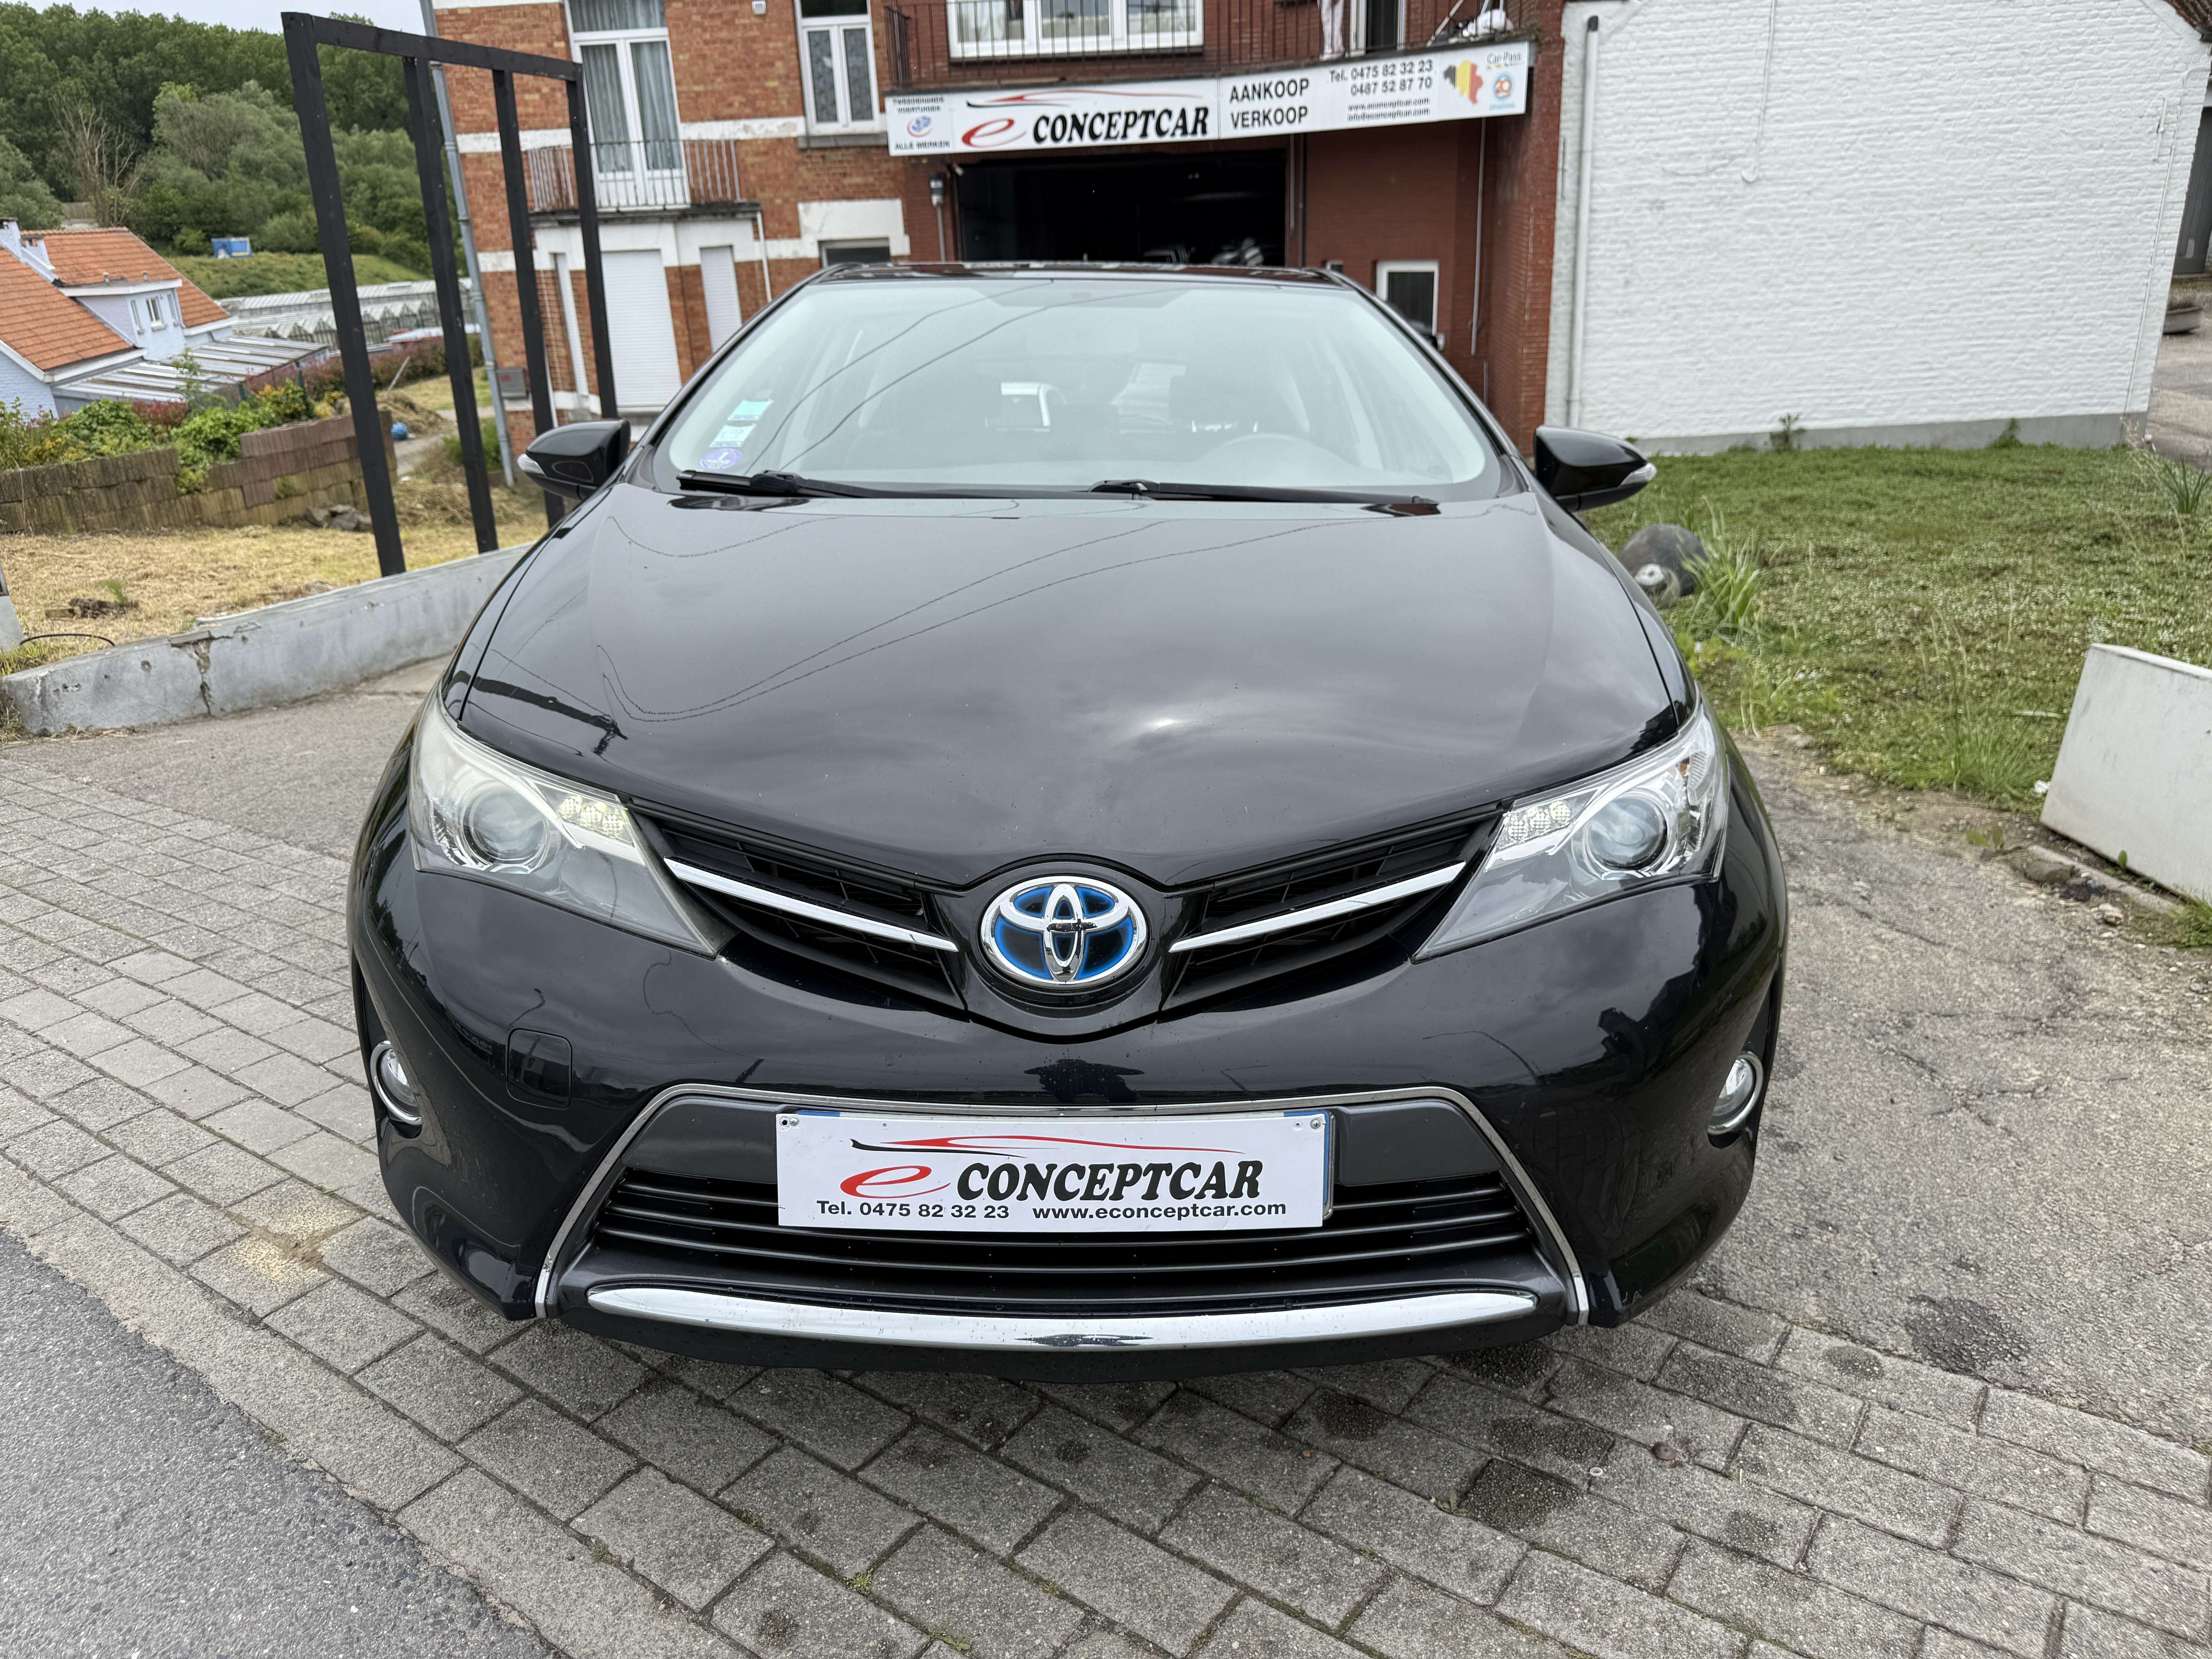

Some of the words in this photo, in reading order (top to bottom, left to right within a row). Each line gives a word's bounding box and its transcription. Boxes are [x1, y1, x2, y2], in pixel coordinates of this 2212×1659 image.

[1330, 68, 1347, 82] Tel.
[1351, 65, 1378, 79] 0475
[1382, 63, 1396, 77] 82
[1400, 61, 1413, 75] 32
[1417, 59, 1432, 73] 23
[1229, 78, 1309, 104] AANKOOP
[1351, 81, 1377, 95] 0487
[1382, 79, 1396, 93] 52
[1400, 77, 1413, 91] 87
[1417, 76, 1432, 89] 70
[1033, 107, 1209, 144] CONCEPTCAR
[1231, 105, 1307, 129] VERKOOP
[957, 1160, 1263, 1201] CONCEPTCAR
[816, 1200, 852, 1215] Tel.
[859, 1202, 911, 1217] 0475
[918, 1203, 944, 1218] 82
[951, 1204, 976, 1218] 32
[984, 1205, 1010, 1219] 23
[1032, 1203, 1286, 1221] www.econceptcar.com
